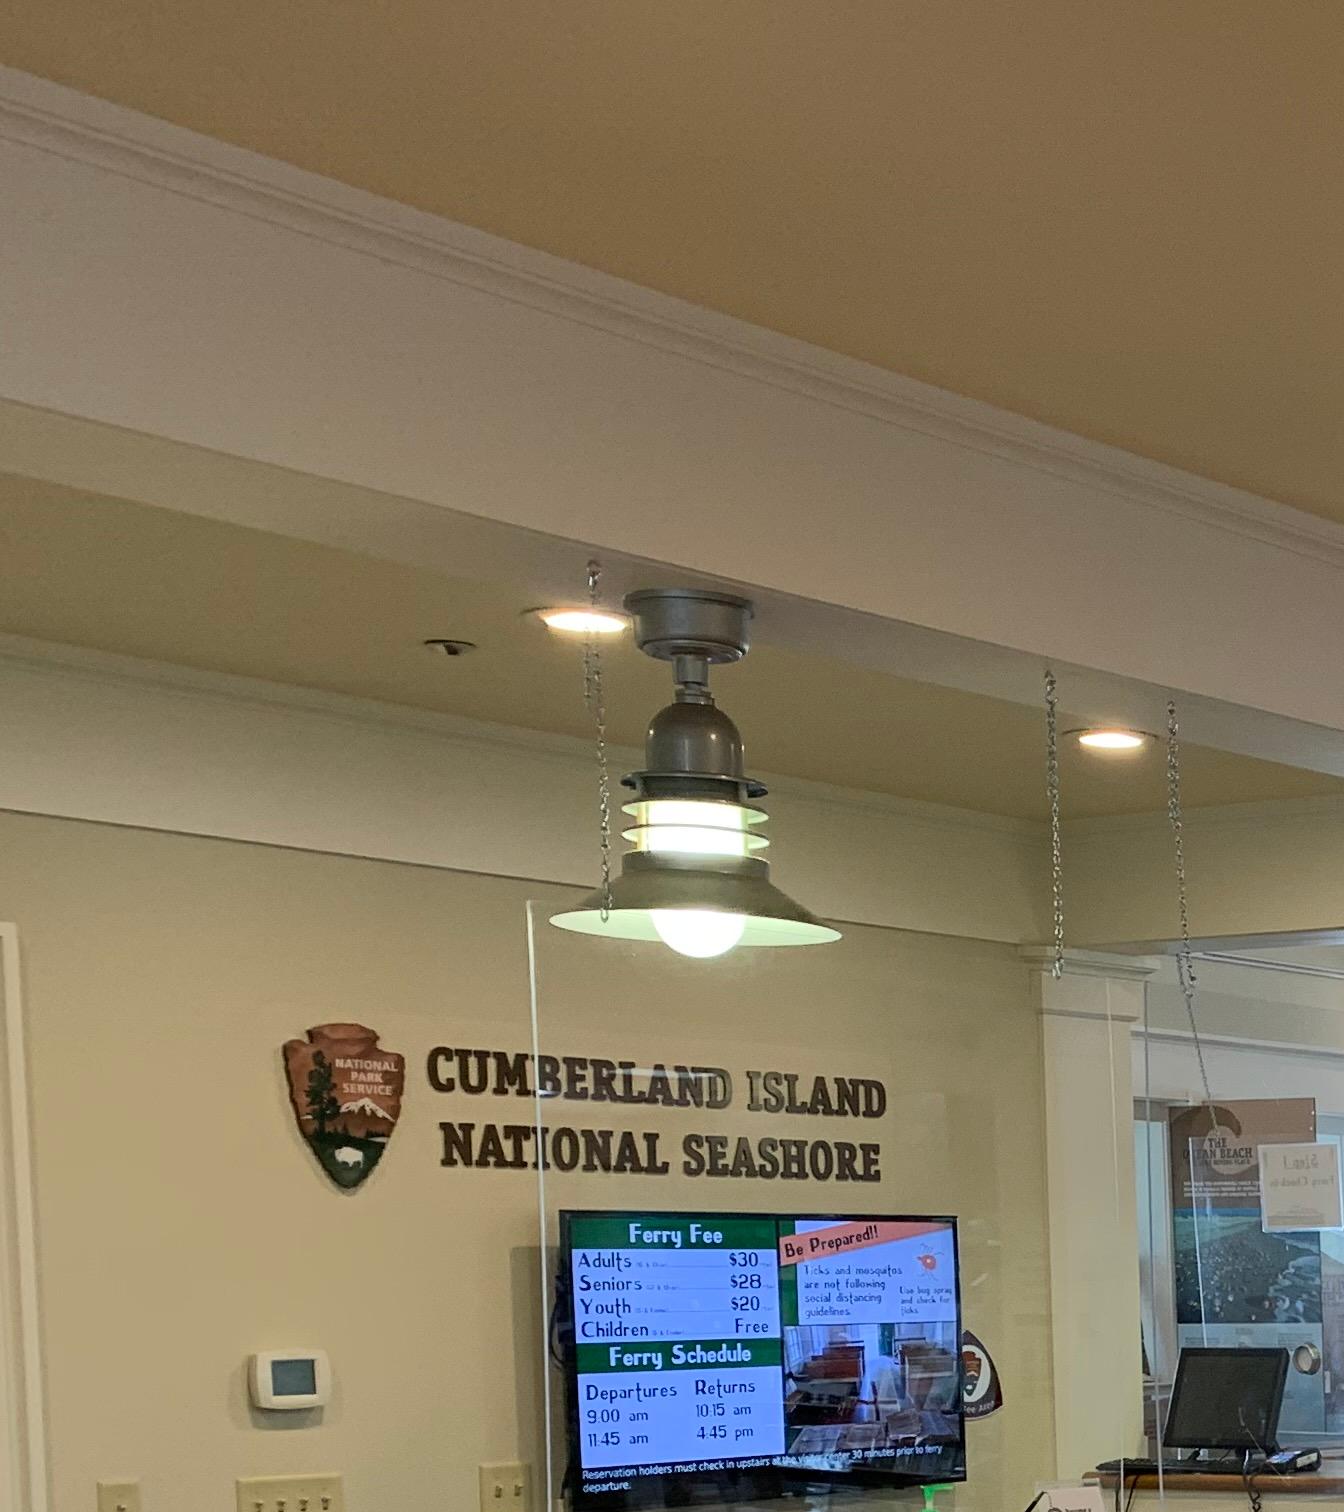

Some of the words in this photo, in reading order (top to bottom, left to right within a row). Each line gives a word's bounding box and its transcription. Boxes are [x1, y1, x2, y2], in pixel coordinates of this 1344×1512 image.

[335, 1058, 399, 1072] NATIONAL
[351, 1071, 384, 1084] PARK
[427, 1046, 732, 1110] CUMBERLAND
[746, 1070, 887, 1118] ISLAND
[342, 1083, 393, 1096] SERVICE
[438, 1121, 670, 1175] NATIONAL
[682, 1134, 881, 1183] SEASHORE
[1183, 1148, 1216, 1159] OEAN
[1220, 1147, 1253, 1158] BEACH
[628, 1223, 682, 1248] Ferry
[689, 1223, 723, 1243] Fee
[784, 1242, 804, 1258] Be
[810, 1225, 879, 1253] Prepared!!
[578, 1252, 632, 1272] Adults
[729, 1252, 759, 1267] $30
[804, 1264, 830, 1275] Ticks
[835, 1264, 851, 1275] and
[855, 1264, 903, 1277] mosquitos
[579, 1274, 642, 1291] Seniors
[730, 1274, 761, 1289] $28
[804, 1281, 819, 1289] are
[824, 1280, 840, 1290] not
[845, 1278, 886, 1290] following
[580, 1298, 631, 1318] Youth
[731, 1296, 760, 1311] $20
[804, 1292, 831, 1303] social
[836, 1292, 882, 1305] distancing
[581, 1321, 649, 1338] Children
[735, 1318, 769, 1334] Free
[609, 1346, 663, 1370] Ferry
[671, 1342, 752, 1365] Schedule
[586, 1382, 677, 1404] Departures
[695, 1378, 756, 1398] Returns
[629, 1413, 649, 1422] am
[733, 1407, 751, 1415] am
[629, 1435, 649, 1444] am
[735, 1428, 754, 1441] pm
[582, 1464, 637, 1480] Reservation
[639, 1463, 672, 1476] holders
[674, 1461, 697, 1473] must
[699, 1458, 725, 1471] check
[726, 1459, 735, 1469] in
[736, 1456, 771, 1469] upstairs
[852, 1449, 863, 1459] 30
[864, 1448, 895, 1458] minutes
[896, 1447, 915, 1458] prior
[916, 1446, 923, 1455] to
[925, 1445, 943, 1456] ferry
